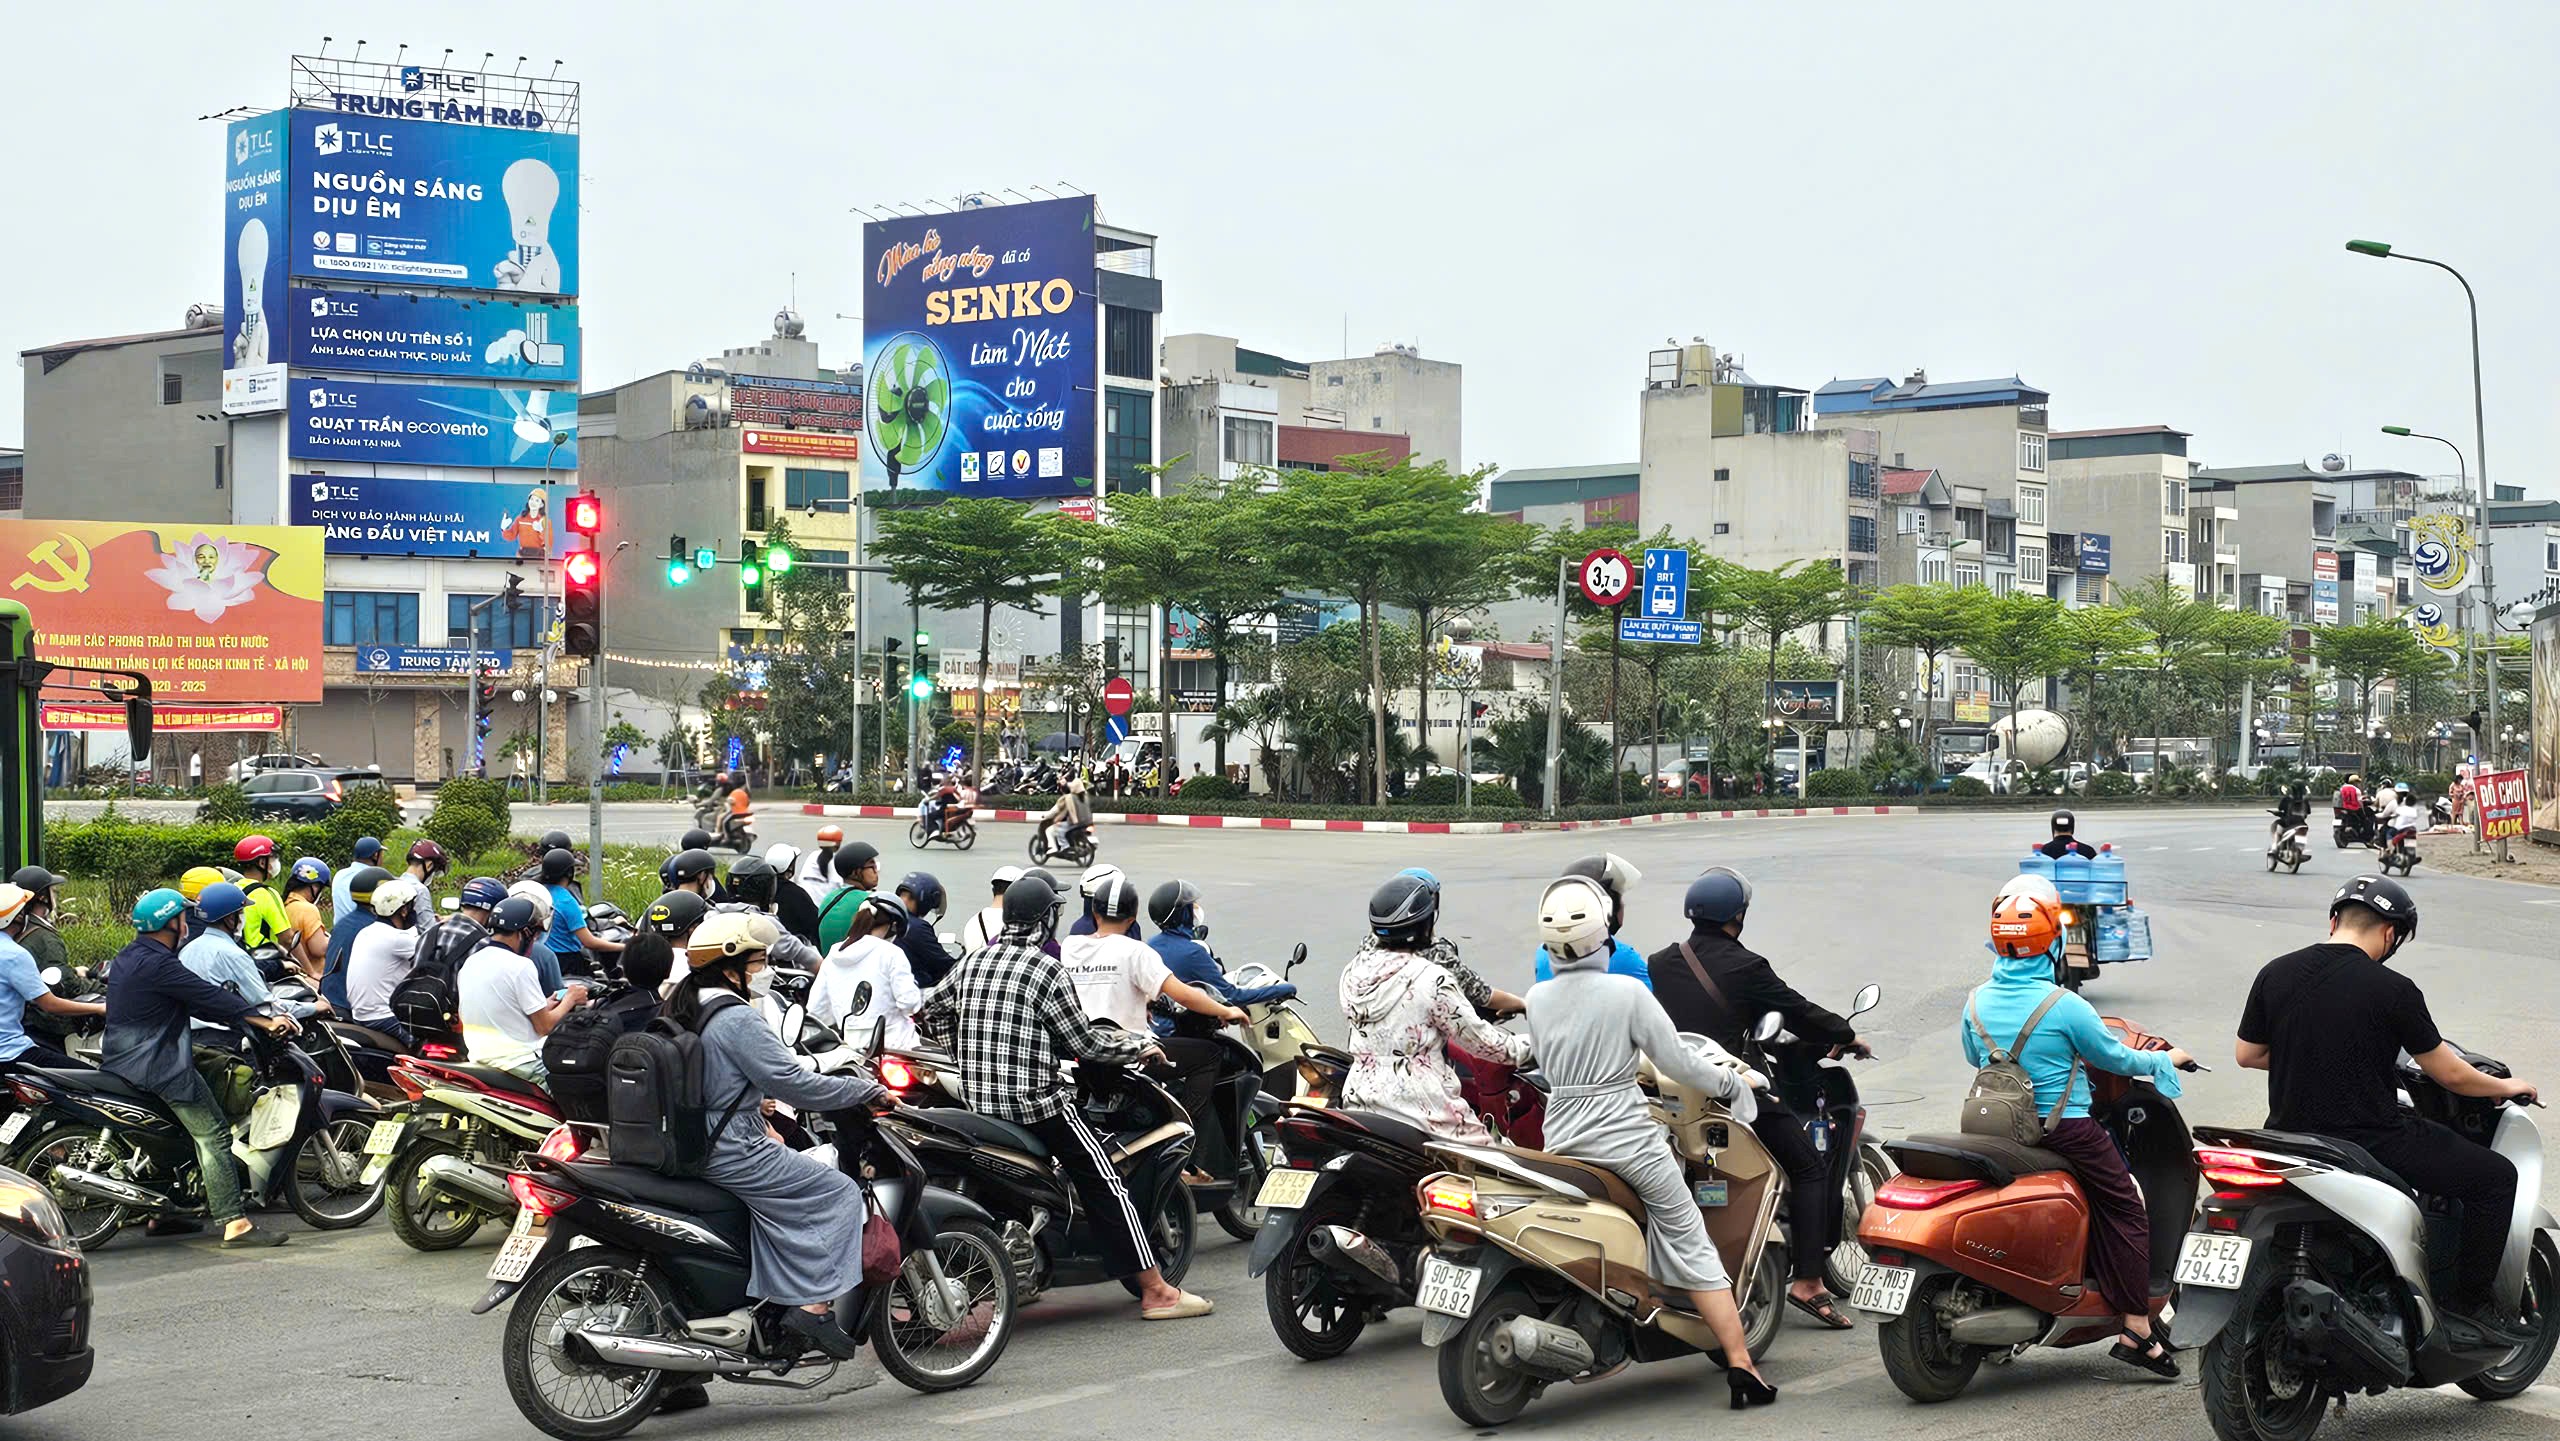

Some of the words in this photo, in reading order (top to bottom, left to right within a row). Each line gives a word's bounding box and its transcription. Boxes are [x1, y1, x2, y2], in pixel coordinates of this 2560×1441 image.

[429, 73, 475, 93] TLC
[332, 92, 423, 118] TRUNG
[429, 98, 485, 123] TÂM
[491, 108, 543, 128] R&D
[250, 130, 272, 150] TLC
[347, 131, 393, 151] TLC
[257, 169, 281, 187] SÁNG
[313, 170, 405, 196] NGUỒN
[414, 179, 483, 201] SÁNG
[254, 191, 268, 208] ÊM
[313, 195, 357, 220] DỊU
[366, 197, 401, 219] ÊM
[352, 260, 372, 269] 6192
[1018, 248, 1031, 263] có
[329, 302, 359, 314] TLC
[926, 278, 1074, 326] SENKO
[311, 326, 340, 342] LỰA
[343, 330, 383, 344] CHỌN
[386, 331, 407, 343] ƯU
[410, 331, 441, 345] TIÊN
[444, 331, 463, 346] SỐ
[467, 336, 473, 347] 1
[970, 344, 1008, 366] Làm
[1013, 328, 1071, 367] Mát
[1005, 376, 1036, 398] cho
[329, 392, 357, 405] TLC
[309, 416, 355, 433] QUẠT
[358, 414, 404, 433] TRẦN
[407, 421, 489, 438] ecovento
[984, 408, 1022, 435] cuộc
[1025, 402, 1065, 431] sống
[330, 487, 360, 499] TLC
[312, 509, 339, 522] DỊCH
[341, 511, 357, 522] VỤ
[385, 509, 417, 522] HÀNH
[323, 522, 363, 540] ÀNG
[367, 523, 405, 542] ĐẦU
[409, 526, 448, 545] VIỆT
[451, 529, 490, 544] NAM
[1657, 572, 1675, 583] BRT
[49, 633, 81, 649] MẠNH
[84, 632, 105, 647] CÁC
[108, 635, 144, 648] PHONG
[147, 633, 173, 648] TRÀO
[176, 636, 192, 648] THI
[218, 634, 238, 649] YÊU
[240, 634, 269, 649] NƯỚC
[78, 654, 114, 669] THÀNH
[152, 657, 169, 672] LỢI
[171, 654, 186, 670] KẾ
[187, 657, 223, 673] HOẠCH
[225, 658, 251, 670] KINH
[253, 654, 267, 670] TẾ
[291, 656, 309, 673] HỘI
[399, 656, 441, 667] TRUNG
[445, 654, 471, 668] TÂM
[151, 680, 171, 692] 020
[181, 680, 207, 692] 2025
[2479, 776, 2497, 808] ĐỒ
[2498, 777, 2525, 804] CHƠI
[2487, 818, 2524, 838] 40K
[2191, 1238, 2240, 1262] 29-E2
[1431, 1264, 1472, 1290] 90-B2
[1860, 1267, 1909, 1290] 22-MD3
[2179, 1259, 2240, 1284] 794.43
[1422, 1284, 1470, 1314] 179.92
[1852, 1286, 1905, 1311] 009.13
